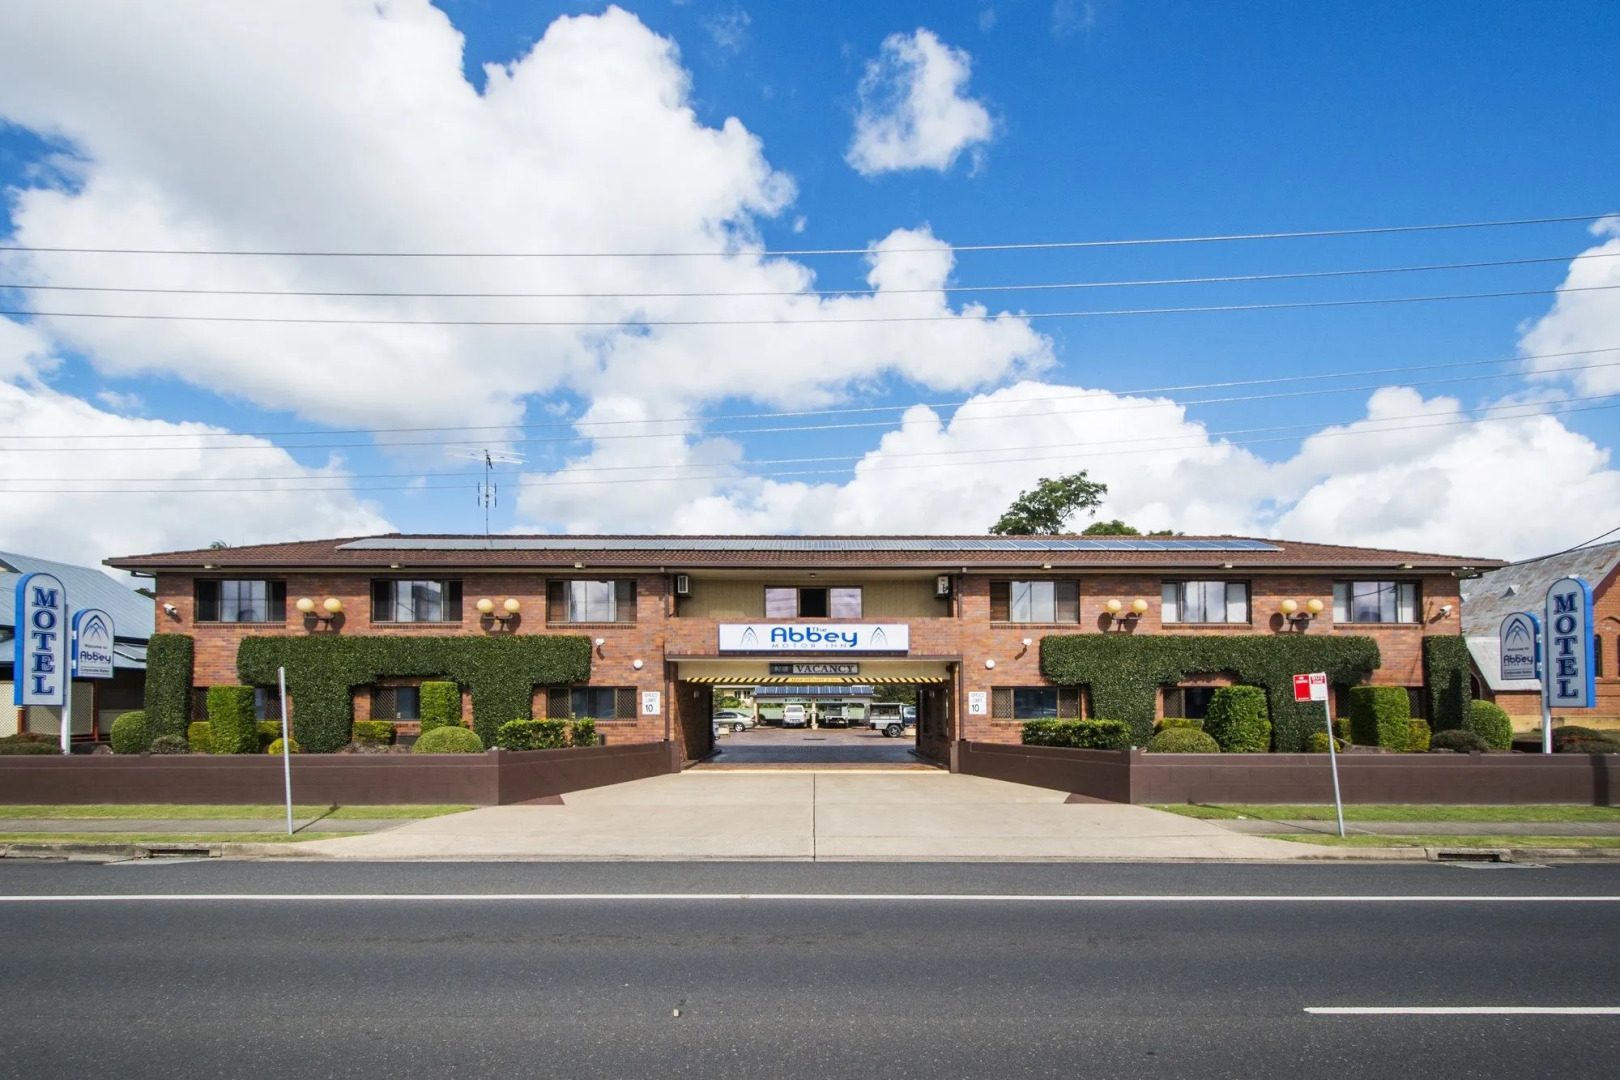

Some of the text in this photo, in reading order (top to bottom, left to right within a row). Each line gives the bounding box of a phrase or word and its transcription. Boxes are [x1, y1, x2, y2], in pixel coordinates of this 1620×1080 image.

[32, 586, 58, 695] MOTEL
[771, 627, 857, 647] Abbey
[1553, 592, 1578, 699] MOTEL
[80, 651, 111, 664] Abbey
[1504, 654, 1533, 664] Abbey
[796, 664, 855, 673] VACANCY
[645, 704, 653, 712] 10
[971, 704, 979, 712] 10
